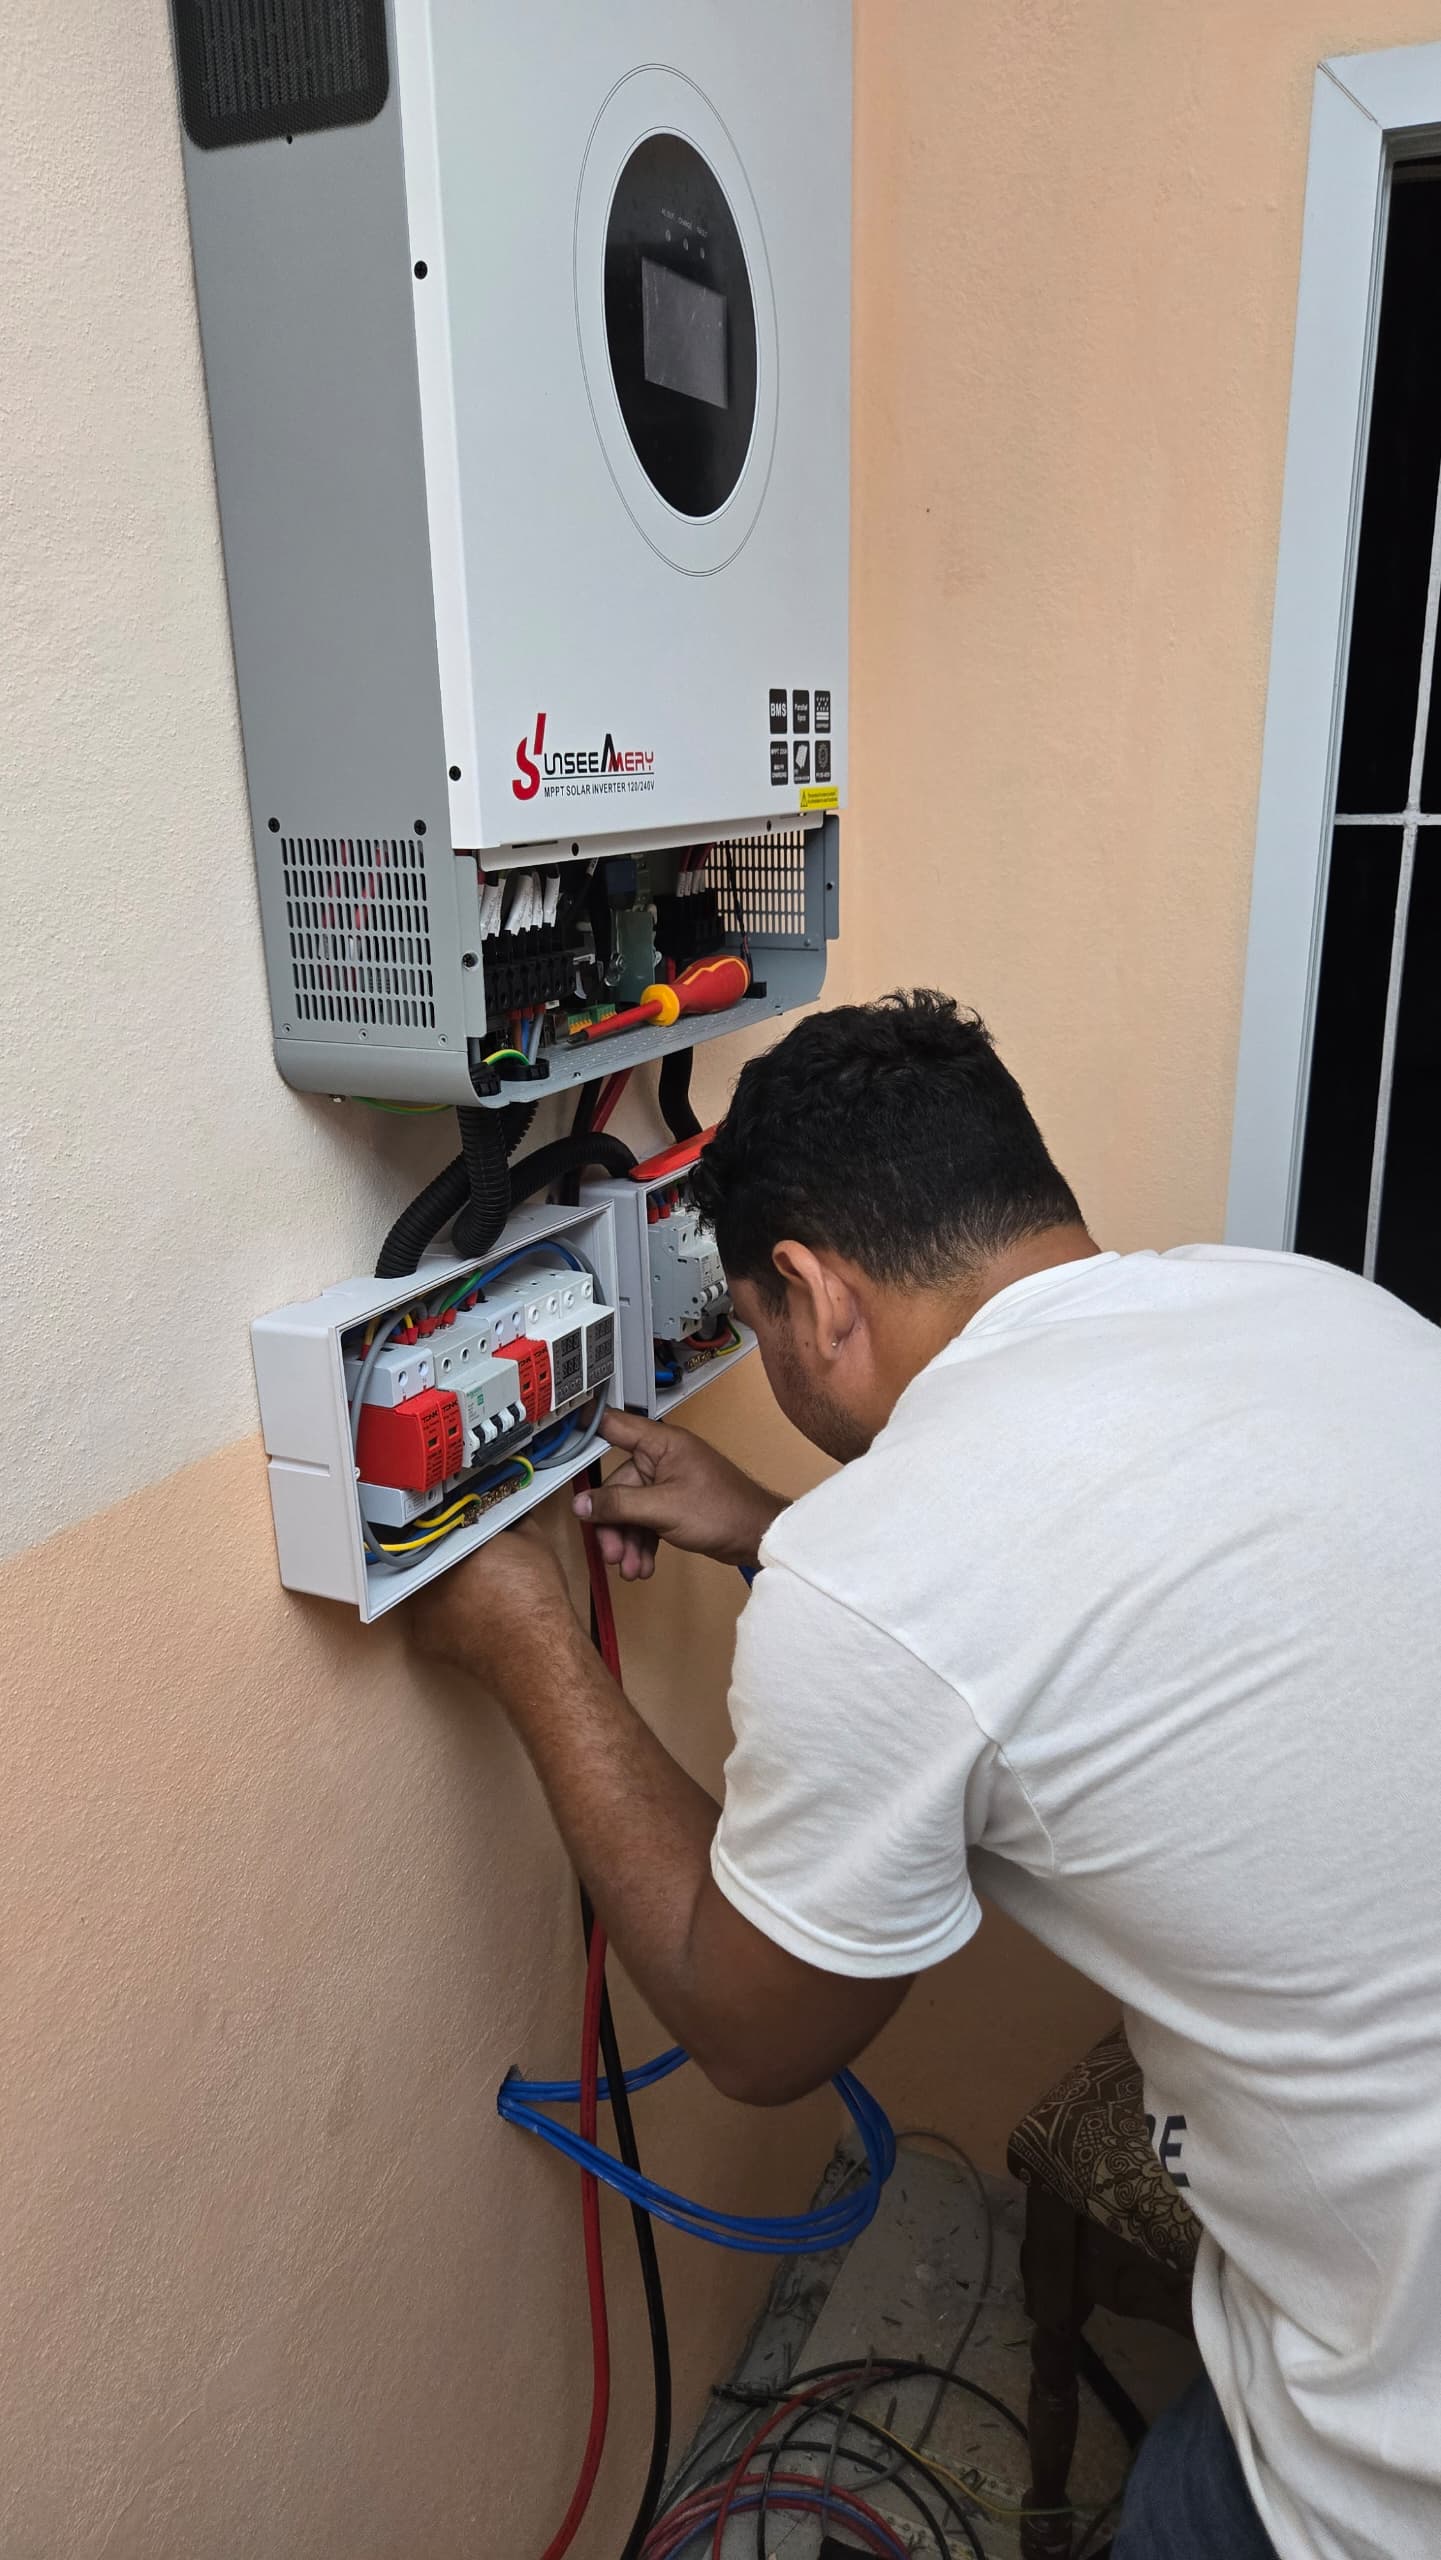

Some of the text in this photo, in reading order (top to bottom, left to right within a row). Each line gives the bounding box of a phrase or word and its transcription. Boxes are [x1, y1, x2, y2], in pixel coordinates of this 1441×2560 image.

[770, 703, 787, 717] BMS
[544, 779, 655, 798] MPPT SOLAR INVERTER 120/240V
[1144, 2113, 1191, 2188] E
